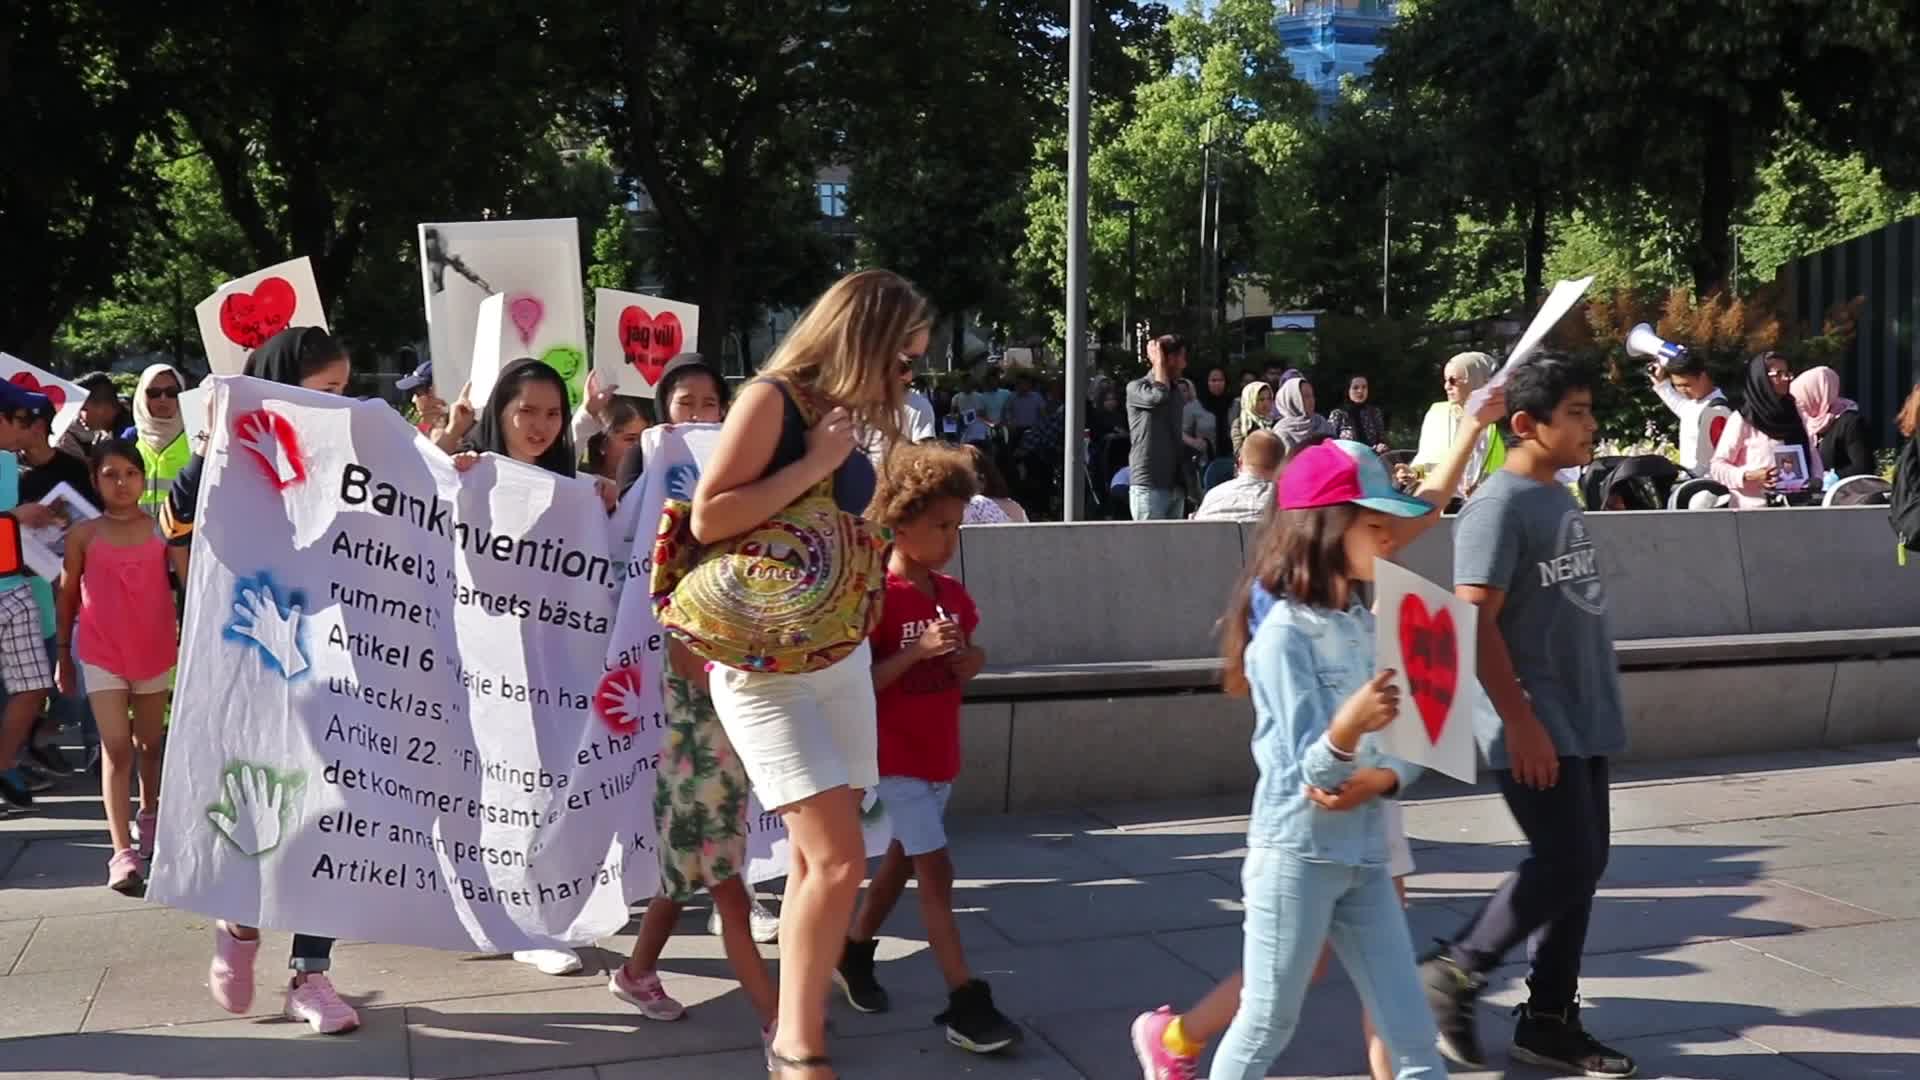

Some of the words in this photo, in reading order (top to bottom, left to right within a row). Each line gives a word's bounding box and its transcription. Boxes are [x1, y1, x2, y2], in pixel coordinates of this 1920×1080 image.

[341, 463, 615, 589] Barnknvention.
[332, 530, 422, 579] Artikel
[537, 597, 609, 635] bästa
[328, 623, 410, 669] Artikel
[418, 648, 435, 673] 6
[501, 675, 550, 704] barn
[396, 736, 442, 767] 22.
[323, 759, 368, 790] det
[371, 771, 463, 813] kommer
[318, 811, 381, 838] eller
[311, 853, 407, 888] Artikel
[415, 867, 448, 894] 31.
[538, 877, 583, 905] har
